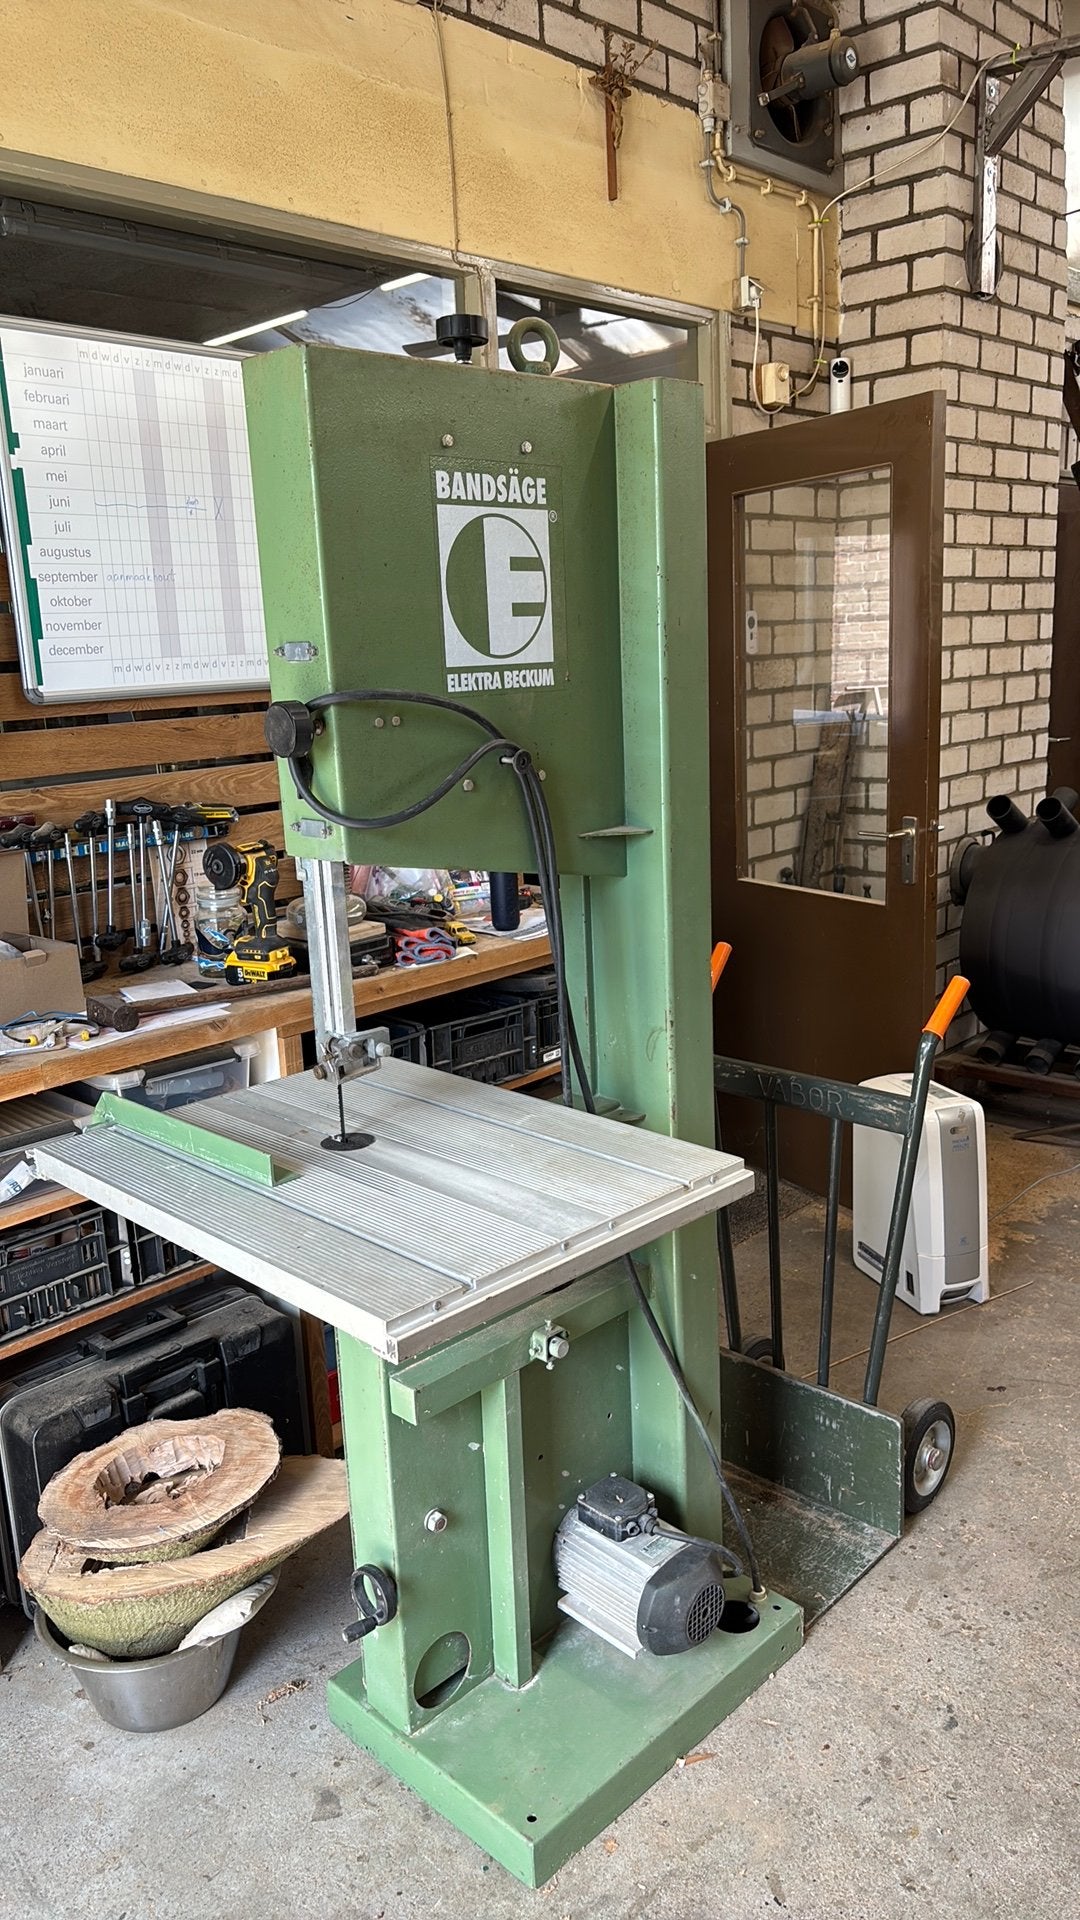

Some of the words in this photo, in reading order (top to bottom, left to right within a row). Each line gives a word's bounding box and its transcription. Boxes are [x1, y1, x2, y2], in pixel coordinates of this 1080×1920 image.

[23, 362, 64, 379] januari
[80, 350, 88, 358] m
[92, 351, 97, 360] d
[102, 353, 109, 361] w
[113, 353, 119, 362] d
[124, 356, 129, 364] v
[135, 357, 140, 365] z
[146, 359, 150, 367] z
[154, 360, 162, 368] m
[165, 360, 170, 369] d
[185, 363, 190, 372] d
[232, 369, 237, 378] d
[24, 389, 70, 405] februari
[33, 419, 68, 431] maart
[40, 444, 66, 458] april
[46, 470, 68, 482] mei
[435, 467, 547, 504] BANDSÄGE
[49, 495, 70, 509] juni
[54, 520, 71, 535] juli
[39, 547, 92, 560] augustus
[38, 571, 98, 584] september
[50, 595, 92, 607] oktober
[45, 619, 102, 631] november
[48, 644, 104, 656] december
[126, 664, 131, 672] d
[146, 662, 151, 671] d
[194, 660, 199, 669] d
[212, 660, 217, 668] d
[447, 670, 502, 692] ELEKTRA
[503, 668, 554, 689] BECKUM
